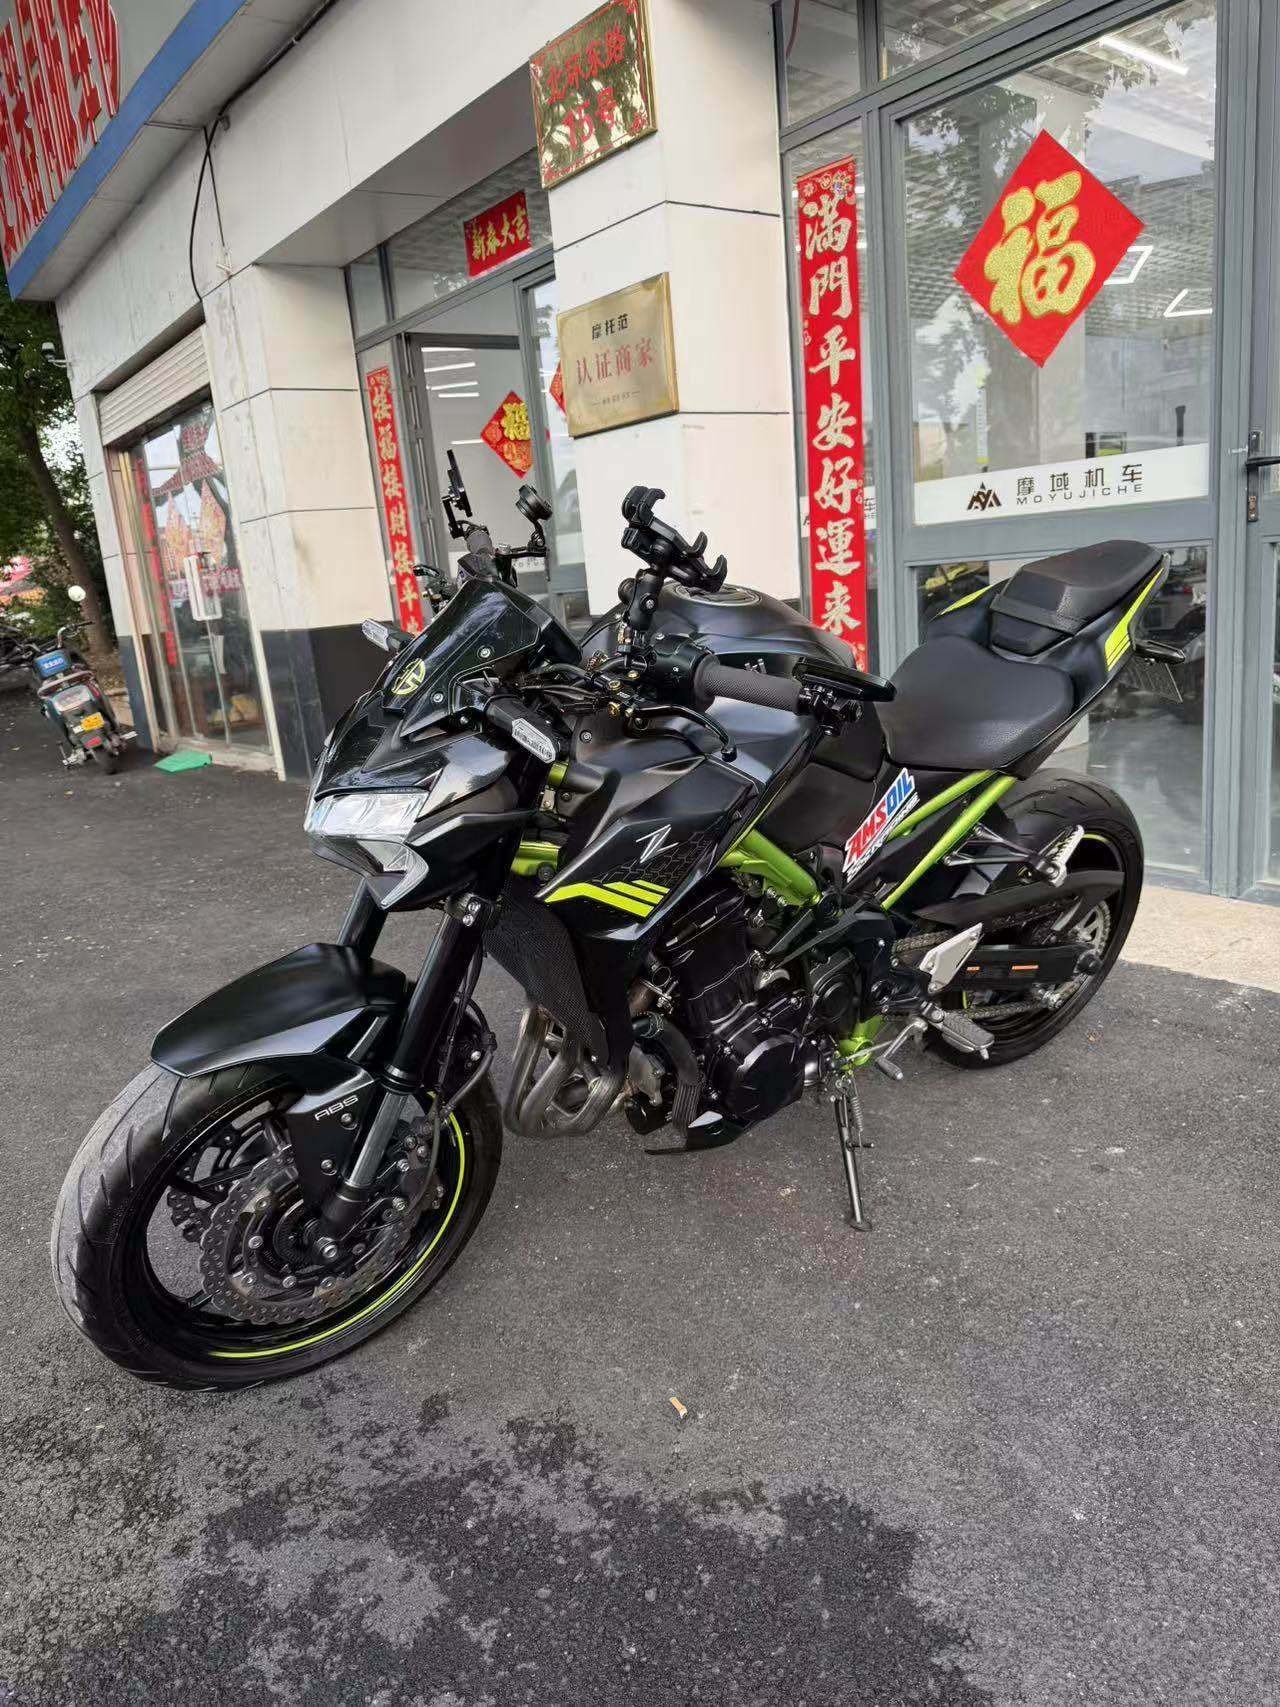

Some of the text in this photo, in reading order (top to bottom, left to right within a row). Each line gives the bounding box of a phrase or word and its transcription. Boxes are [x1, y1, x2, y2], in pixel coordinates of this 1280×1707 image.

[984, 170, 1096, 326] 福
[576, 338, 656, 385] 认证商家
[1016, 464, 1143, 497] 摩域机车
[1016, 483, 1143, 506] MOYUJICHE
[844, 767, 915, 868] AMSOIL
[314, 1094, 359, 1121] ABS
